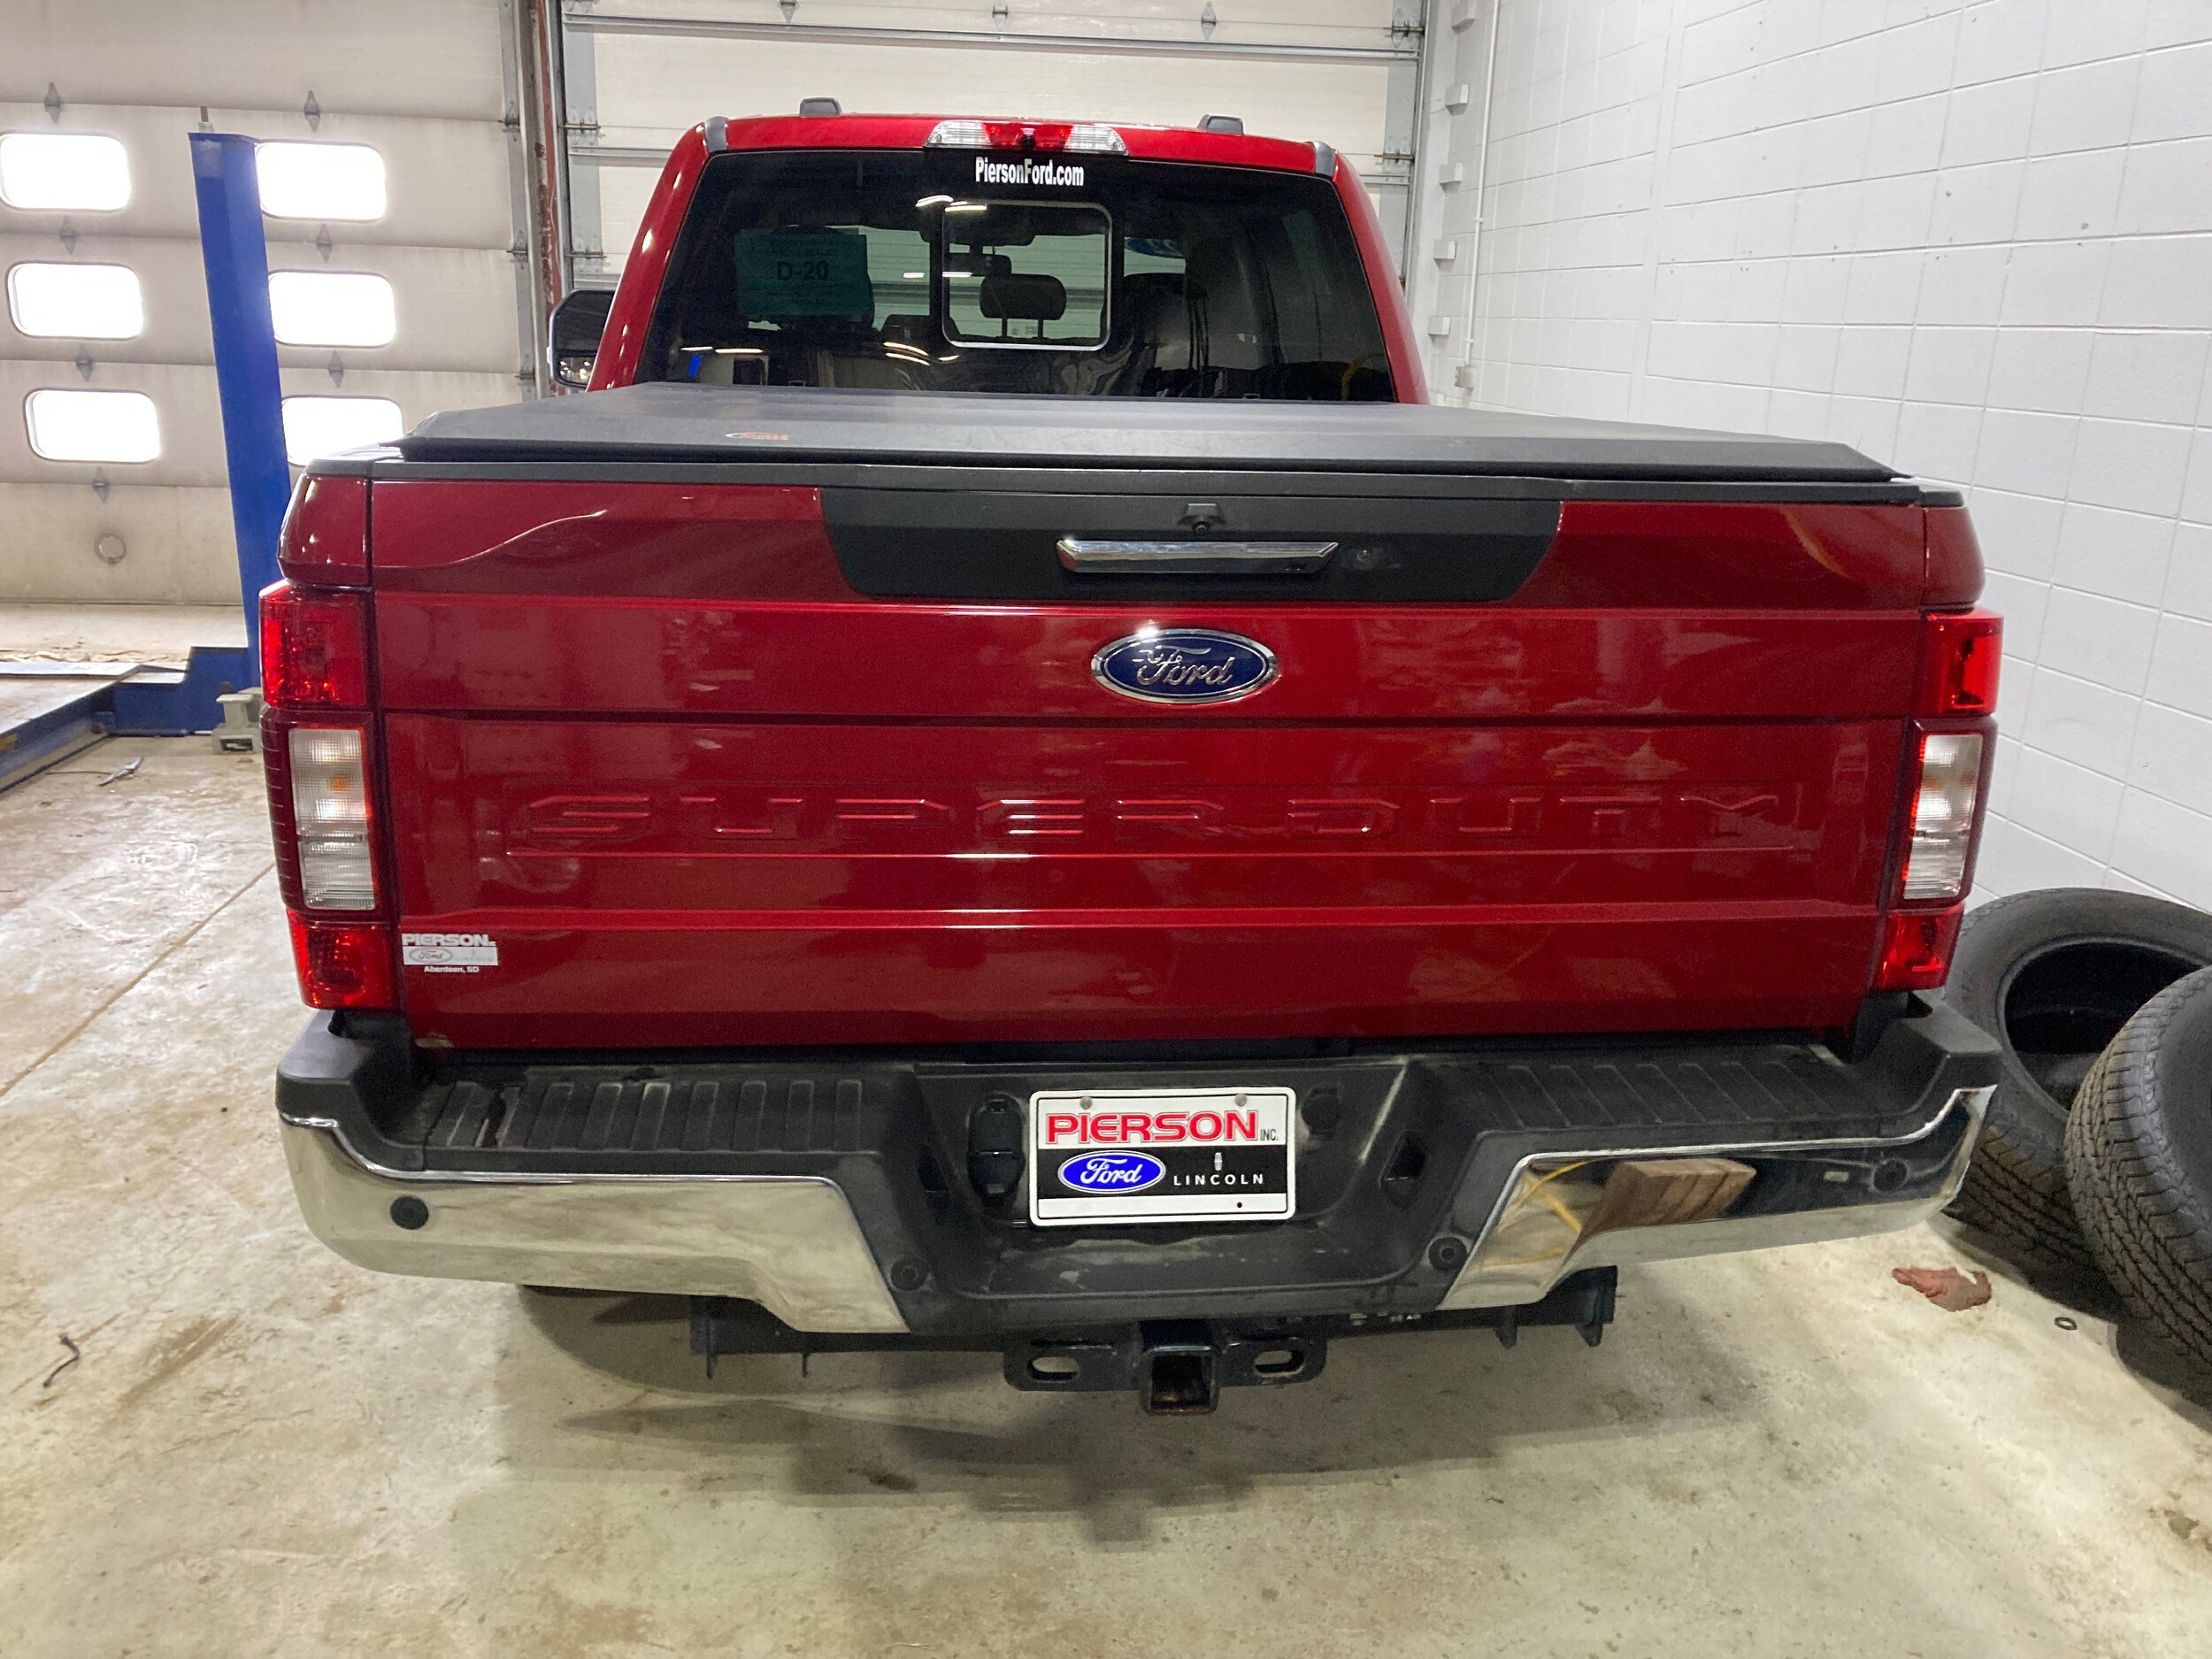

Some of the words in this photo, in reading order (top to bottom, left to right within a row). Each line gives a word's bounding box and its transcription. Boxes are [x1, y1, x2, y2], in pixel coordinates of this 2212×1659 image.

[975, 157, 1084, 186] PiersonFord.com
[777, 260, 829, 280] D-20
[1132, 645, 1235, 686] Ford
[526, 795, 1232, 841] SUPER
[1287, 795, 1780, 839] DUTY
[402, 933, 489, 946] PIERSON
[418, 949, 443, 960] Ford
[1046, 1110, 1258, 1144] PIERSON
[1260, 1128, 1279, 1141] INC.
[1079, 1156, 1143, 1185] Ford
[1173, 1173, 1263, 1186] LINCOLN
